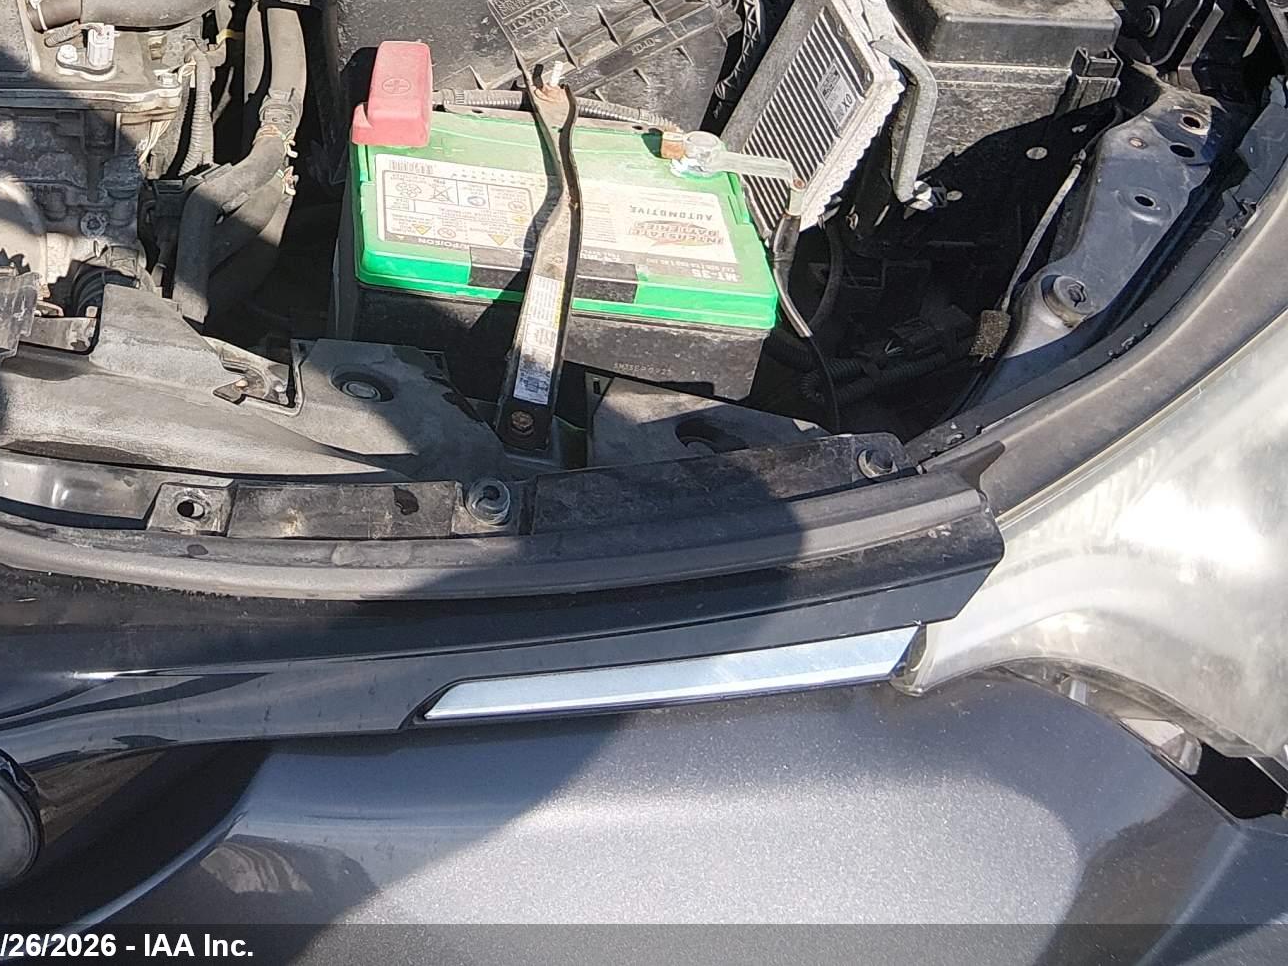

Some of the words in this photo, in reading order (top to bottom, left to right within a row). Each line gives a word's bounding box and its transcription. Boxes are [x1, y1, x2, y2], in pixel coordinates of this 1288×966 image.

[630, 205, 713, 221] AUTOMOTIVE
[632, 227, 723, 245] INTERSTATE
[636, 222, 718, 237] BATTERIES
